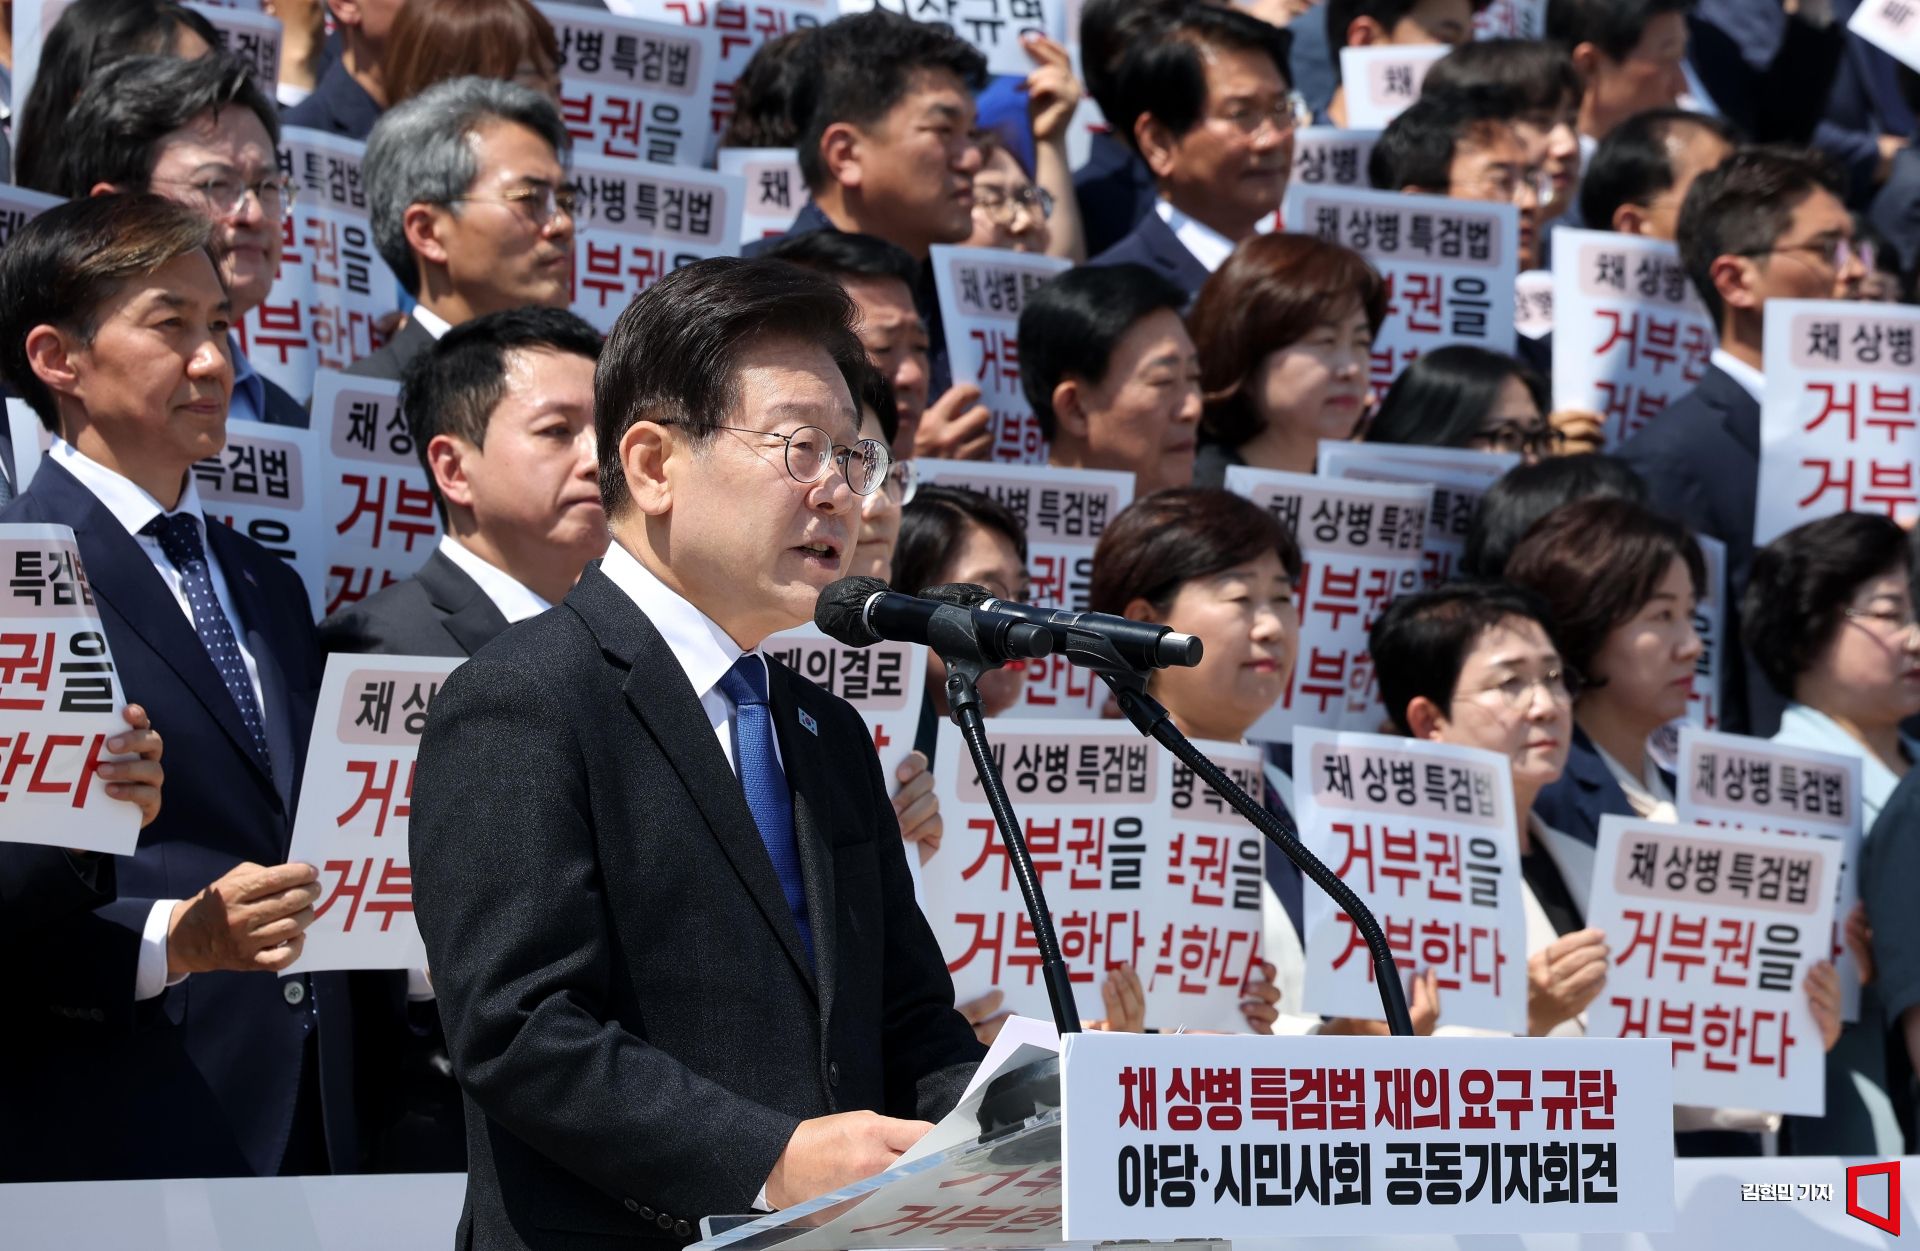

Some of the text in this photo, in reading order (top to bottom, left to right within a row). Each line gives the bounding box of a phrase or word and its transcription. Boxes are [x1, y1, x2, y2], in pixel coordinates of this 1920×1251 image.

[610, 35, 691, 88] 특검법
[635, 183, 712, 236] 특검법
[760, 170, 791, 208] 채
[1347, 208, 1400, 252] 상병
[1407, 214, 1491, 260] 특검법
[1384, 273, 1491, 336] 권을
[1595, 252, 1686, 302] 채 상병
[232, 300, 385, 372] 부한다
[1808, 322, 1914, 366] 채 상병
[347, 401, 379, 451] 채
[1804, 382, 1920, 443] 거부
[1037, 491, 1108, 537] 특검법
[1799, 459, 1920, 521] 거부
[1311, 498, 1373, 547] 상병
[355, 681, 395, 734] 채
[1014, 744, 1068, 794] 상병
[1076, 745, 1147, 794] 특검법
[1323, 754, 1494, 818] 채 상병 특검법
[1723, 758, 1772, 805] 상병
[1780, 765, 1843, 819] 특검법
[961, 817, 1146, 891] 거부권을
[1331, 822, 1502, 909] 거부권을
[1628, 842, 1812, 905] 채 상병 특검법
[947, 910, 1144, 985] 거부한다
[1331, 911, 1506, 997] 거부한다
[1615, 910, 1801, 992] 거부권을
[1611, 997, 1796, 1078] 거부한다
[1118, 1067, 1618, 1131] 채 상병 특검법 재의 요구 규탄
[1384, 1142, 1618, 1206] 공동기자회견
